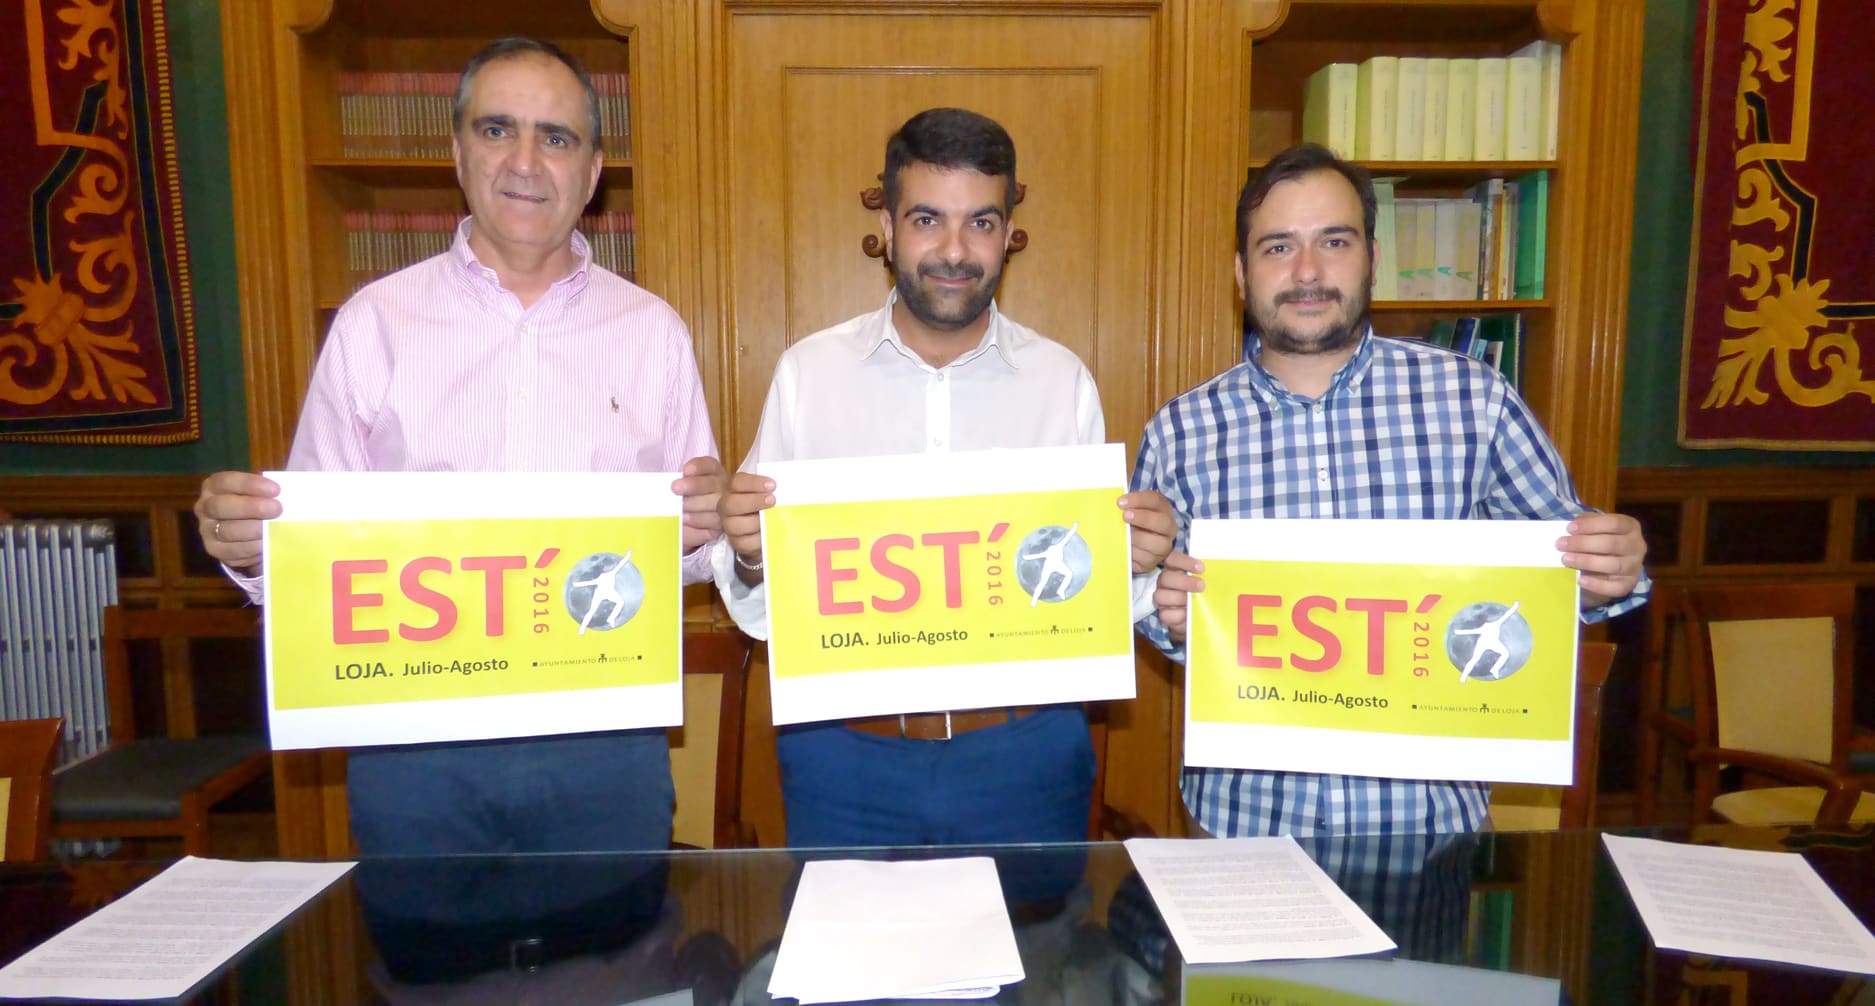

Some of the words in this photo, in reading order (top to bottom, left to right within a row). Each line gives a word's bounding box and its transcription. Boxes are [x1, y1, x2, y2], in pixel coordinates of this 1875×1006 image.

[986, 551, 1003, 606] 2016
[533, 576, 550, 634] 2016
[821, 632, 869, 649] LOJA.
[876, 629, 968, 645] Julio-Agosto
[1413, 622, 1430, 678] 2016
[335, 662, 393, 680] LOJA.
[402, 658, 509, 676] Julio-Agosto
[539, 658, 597, 667] AYUNTAMIENTO
[1237, 684, 1286, 701] LOJA.
[1292, 690, 1389, 709] Julio-Agosto
[1419, 704, 1479, 713] AYUNTAMIENTO
